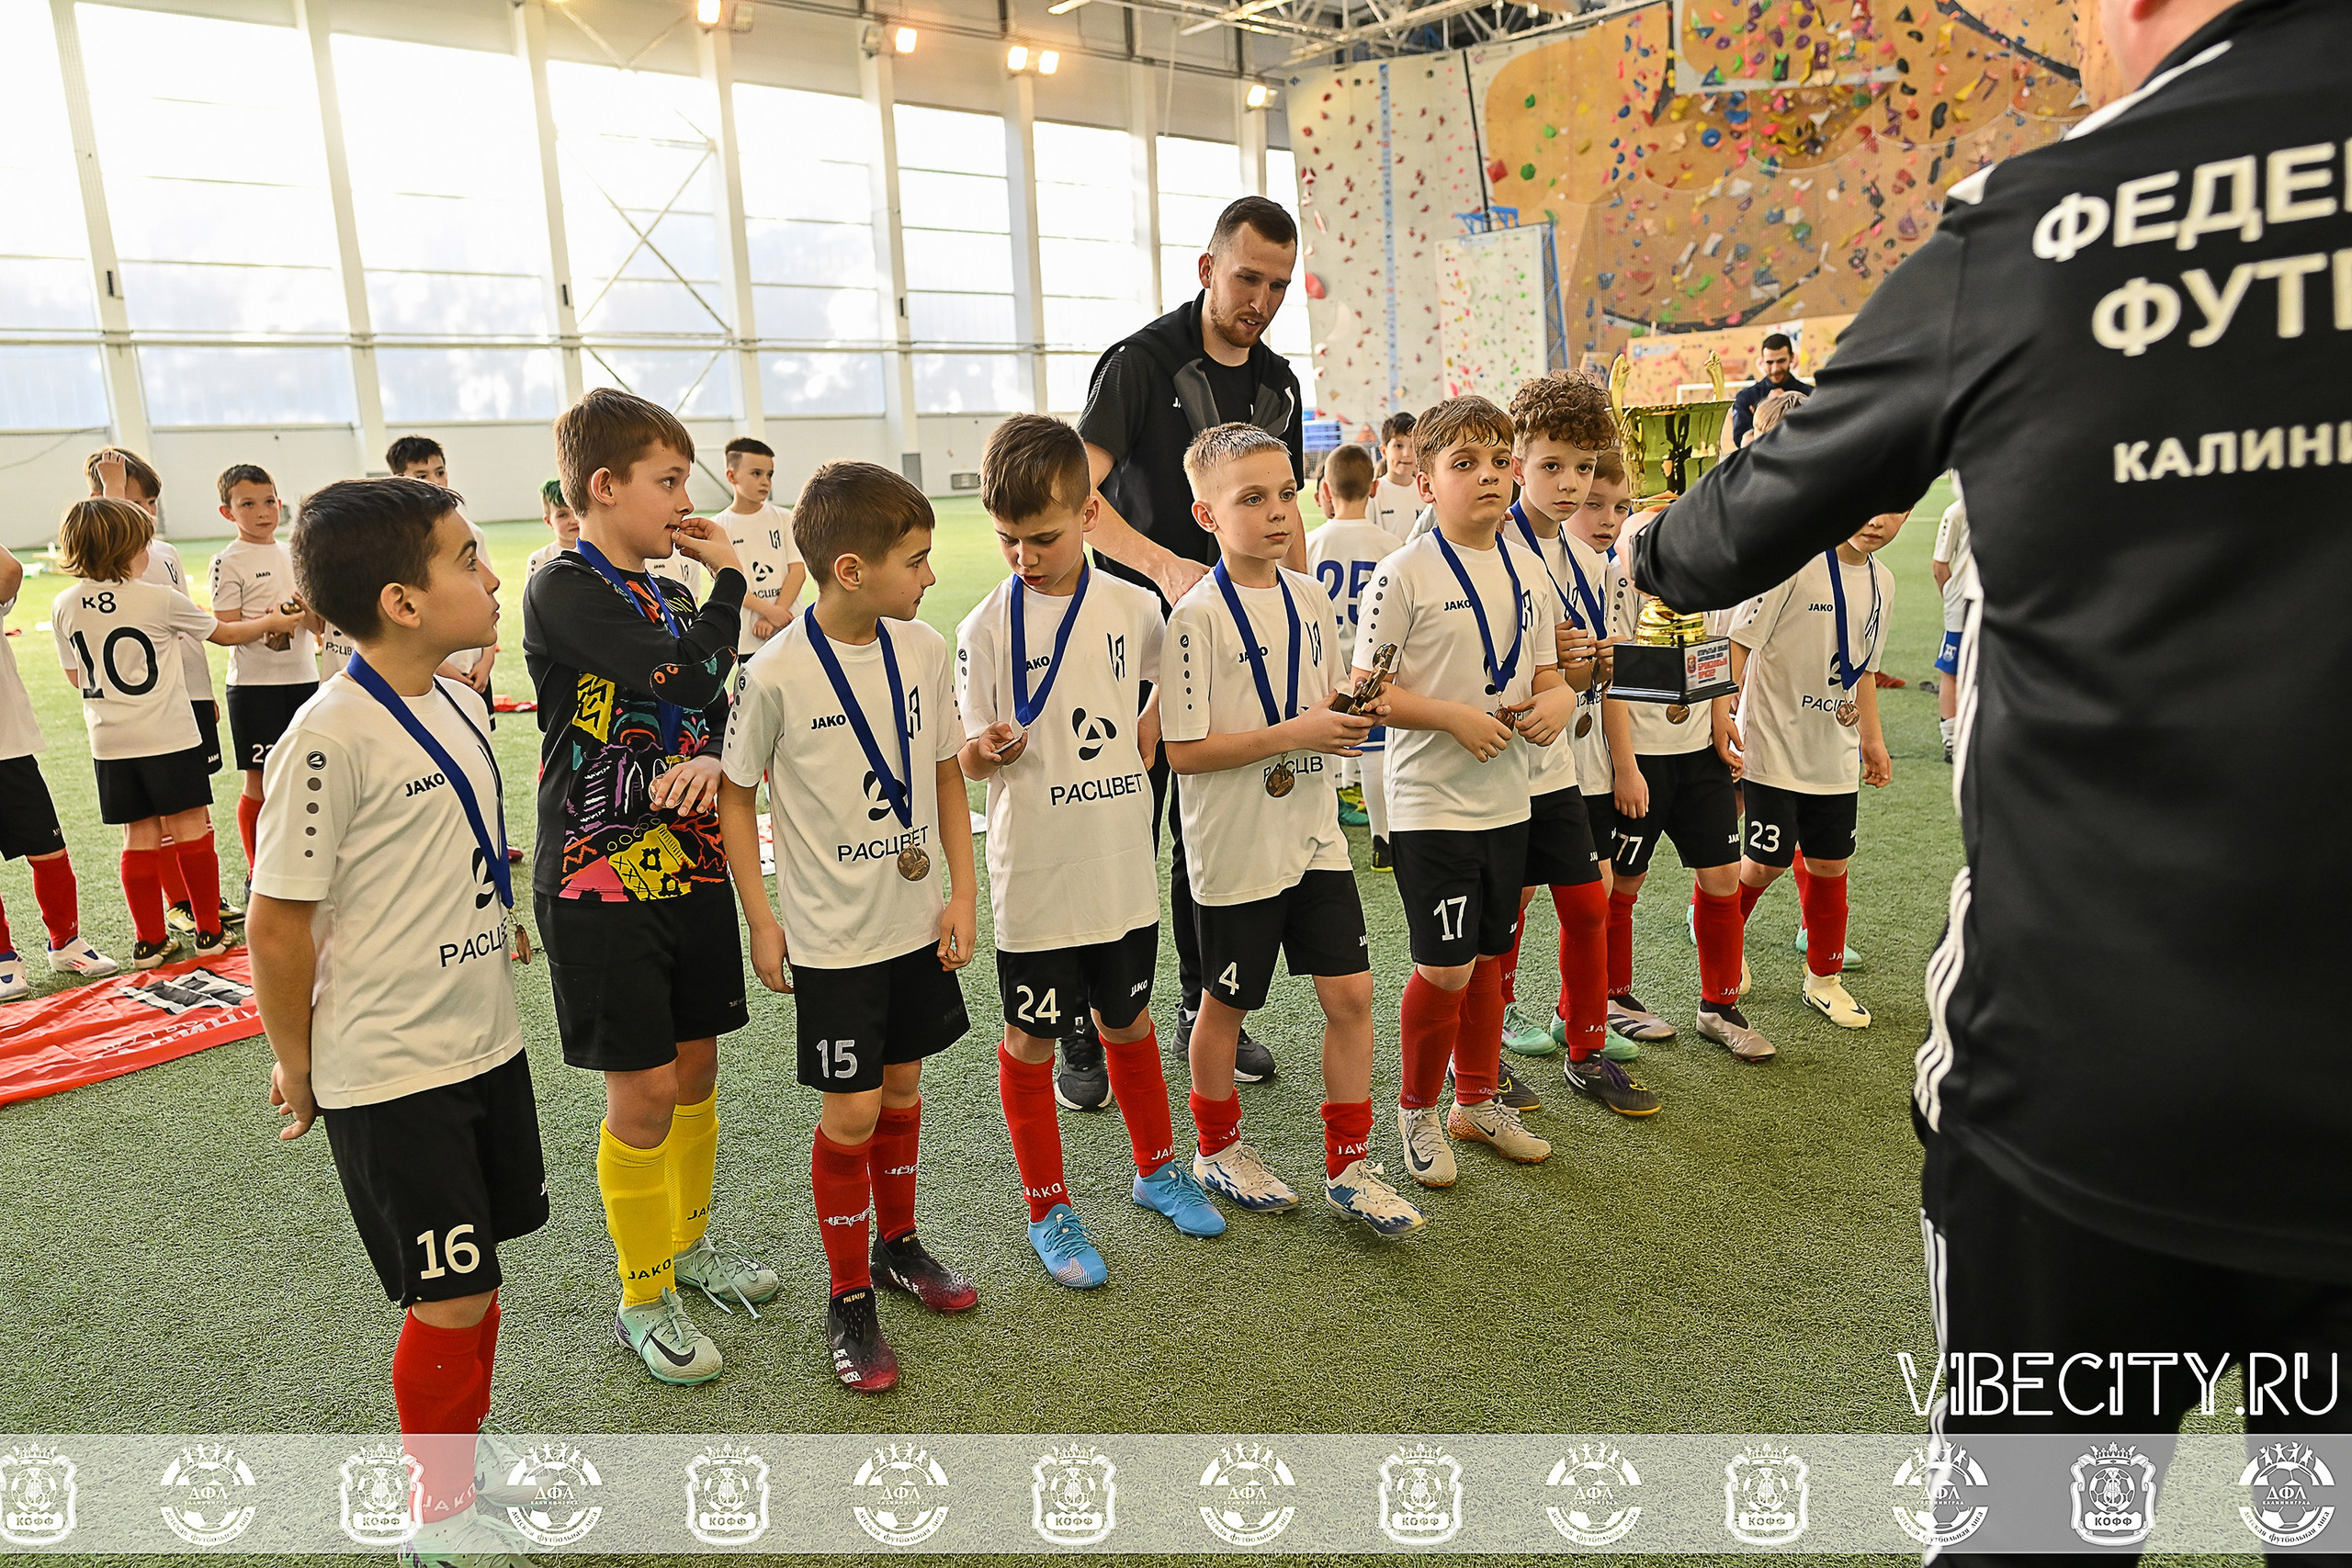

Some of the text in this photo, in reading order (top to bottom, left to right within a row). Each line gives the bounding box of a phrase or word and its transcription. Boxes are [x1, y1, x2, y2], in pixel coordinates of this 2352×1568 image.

[2032, 137, 2352, 263] ФЕДЕ
[2091, 246, 2352, 357] ФУТ
[1317, 559, 1377, 626] 25
[1808, 603, 1834, 613] JAKO
[70, 626, 158, 699] 10
[1025, 655, 1050, 671] AKO
[1238, 646, 1269, 663] JAO
[811, 714, 846, 730] JAKO
[405, 772, 446, 797] JAKO
[1050, 773, 1143, 807] РАСЦВЕТ
[837, 825, 929, 863] РАСЦВЕТ
[1616, 831, 1643, 865] 77
[1749, 820, 1781, 853] 23
[1433, 896, 1467, 942] 17
[1218, 961, 1239, 996] 4
[1608, 985, 1631, 996] AKO
[1016, 985, 1061, 1025] 24
[816, 1039, 858, 1079] 15
[1024, 1182, 1063, 1200] JAKO
[416, 1224, 481, 1280] 16
[628, 1258, 672, 1280] JAKO
